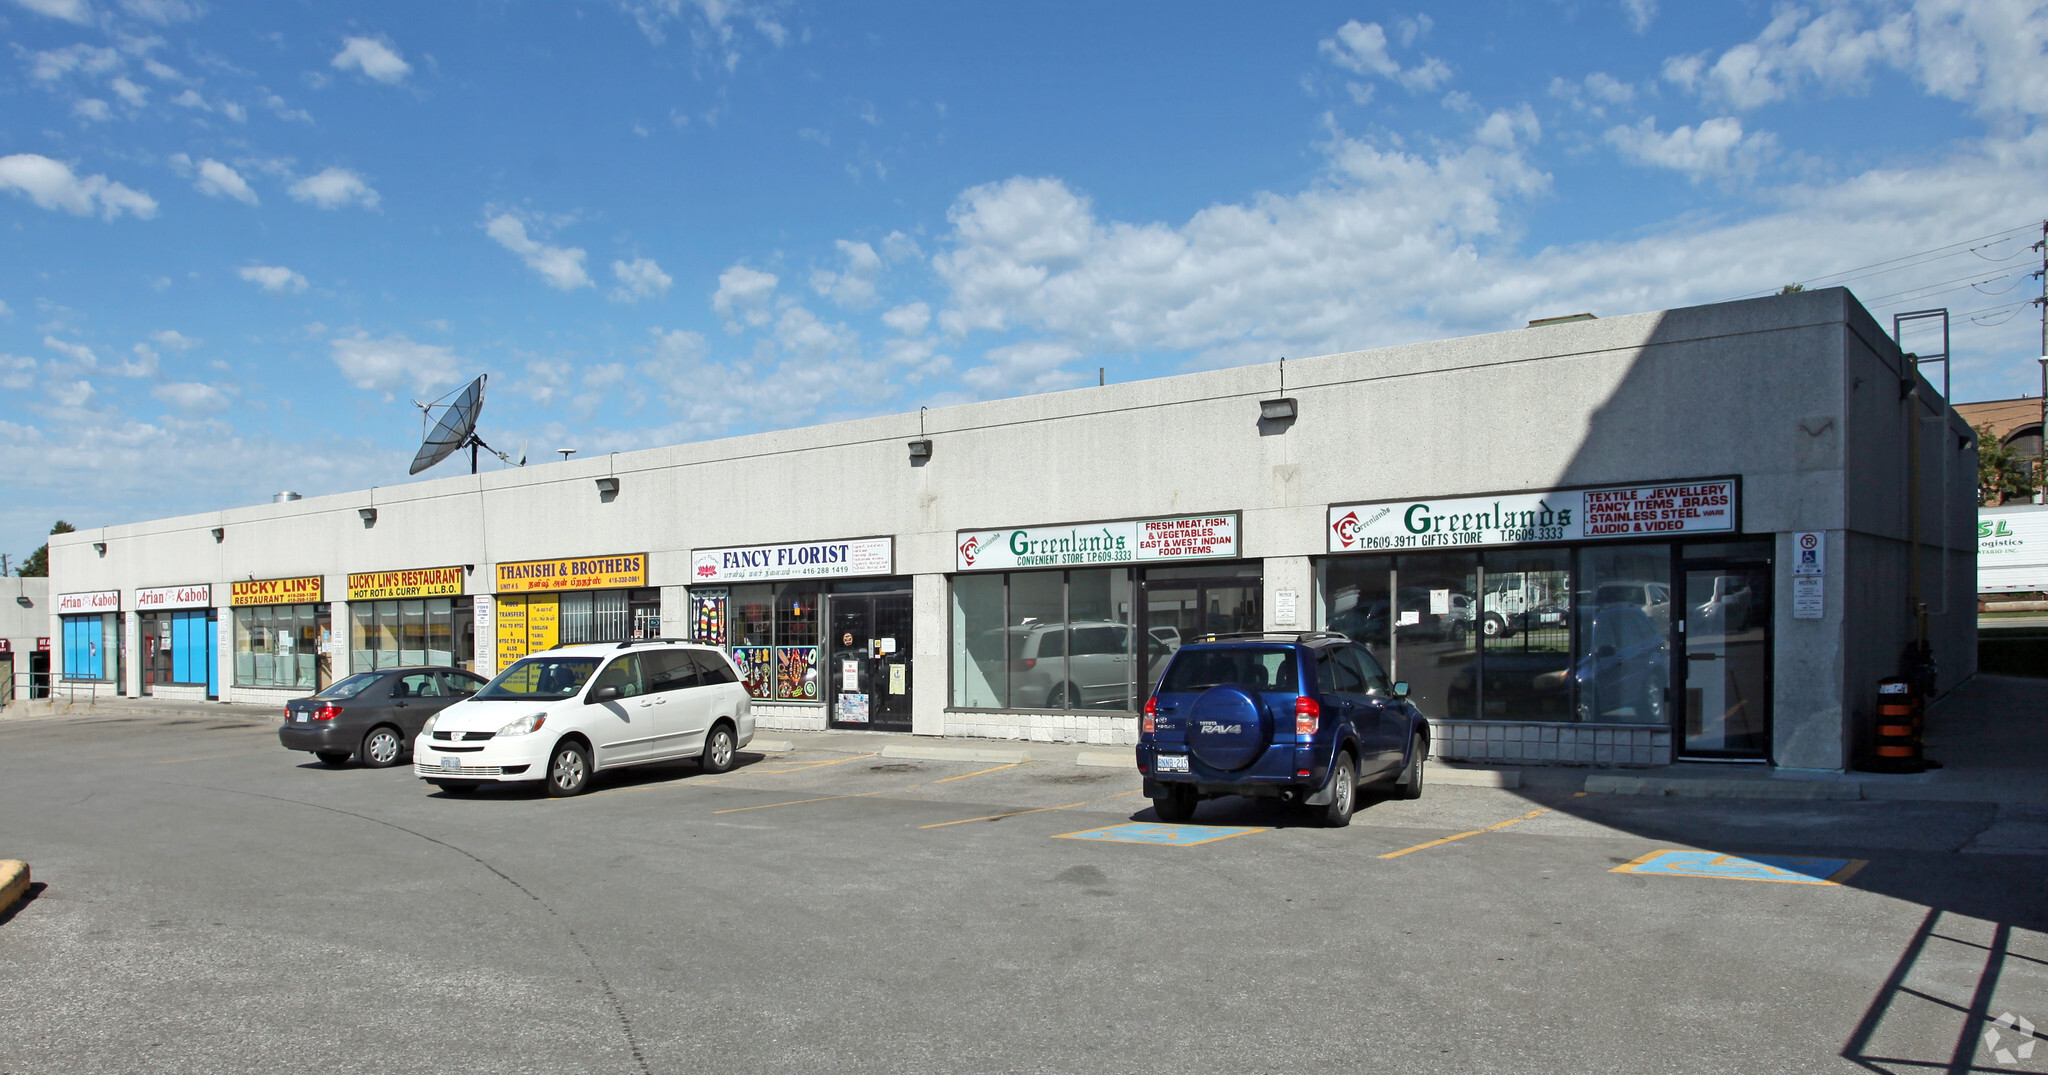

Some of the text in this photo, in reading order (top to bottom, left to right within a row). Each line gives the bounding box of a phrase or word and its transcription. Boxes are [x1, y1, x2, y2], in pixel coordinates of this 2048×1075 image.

[1634, 499, 1674, 511] ITEMS
[1352, 506, 1391, 533] Greenlands
[1403, 499, 1572, 534] Greenlands
[1661, 508, 1701, 520] STEEL
[1145, 521, 1174, 531] FRESH
[1633, 522, 1643, 532] &
[1645, 520, 1684, 531] VIDEO
[1009, 527, 1126, 556] Greenlands
[1140, 536, 1232, 549] EAST & WEST INDIAN
[1148, 532, 1154, 540] &
[1422, 533, 1449, 546] GIFTS
[1451, 531, 1483, 544] STORE
[1981, 539, 2023, 548] ogistics
[723, 549, 772, 569] FANCY
[777, 544, 849, 566] FLORIST
[1158, 547, 1182, 556] FOOD
[1017, 554, 1059, 566] CONVENIENT
[1062, 552, 1084, 564] STORE
[500, 557, 641, 580] THANISHI & BROTHERS
[832, 566, 849, 574] 1419
[349, 569, 462, 590] LUCKY LIN'S RESTAURANT
[232, 578, 320, 596] LUCKY LIN'S
[353, 584, 457, 599] HOT ROTI & CURRY L.L.B.O.
[60, 596, 81, 612] Arian
[91, 593, 118, 607] Kabob
[138, 590, 164, 608] Arian
[176, 586, 208, 603] Kabob
[234, 594, 285, 605] RESTAURANT
[1201, 724, 1242, 734] RAV4
